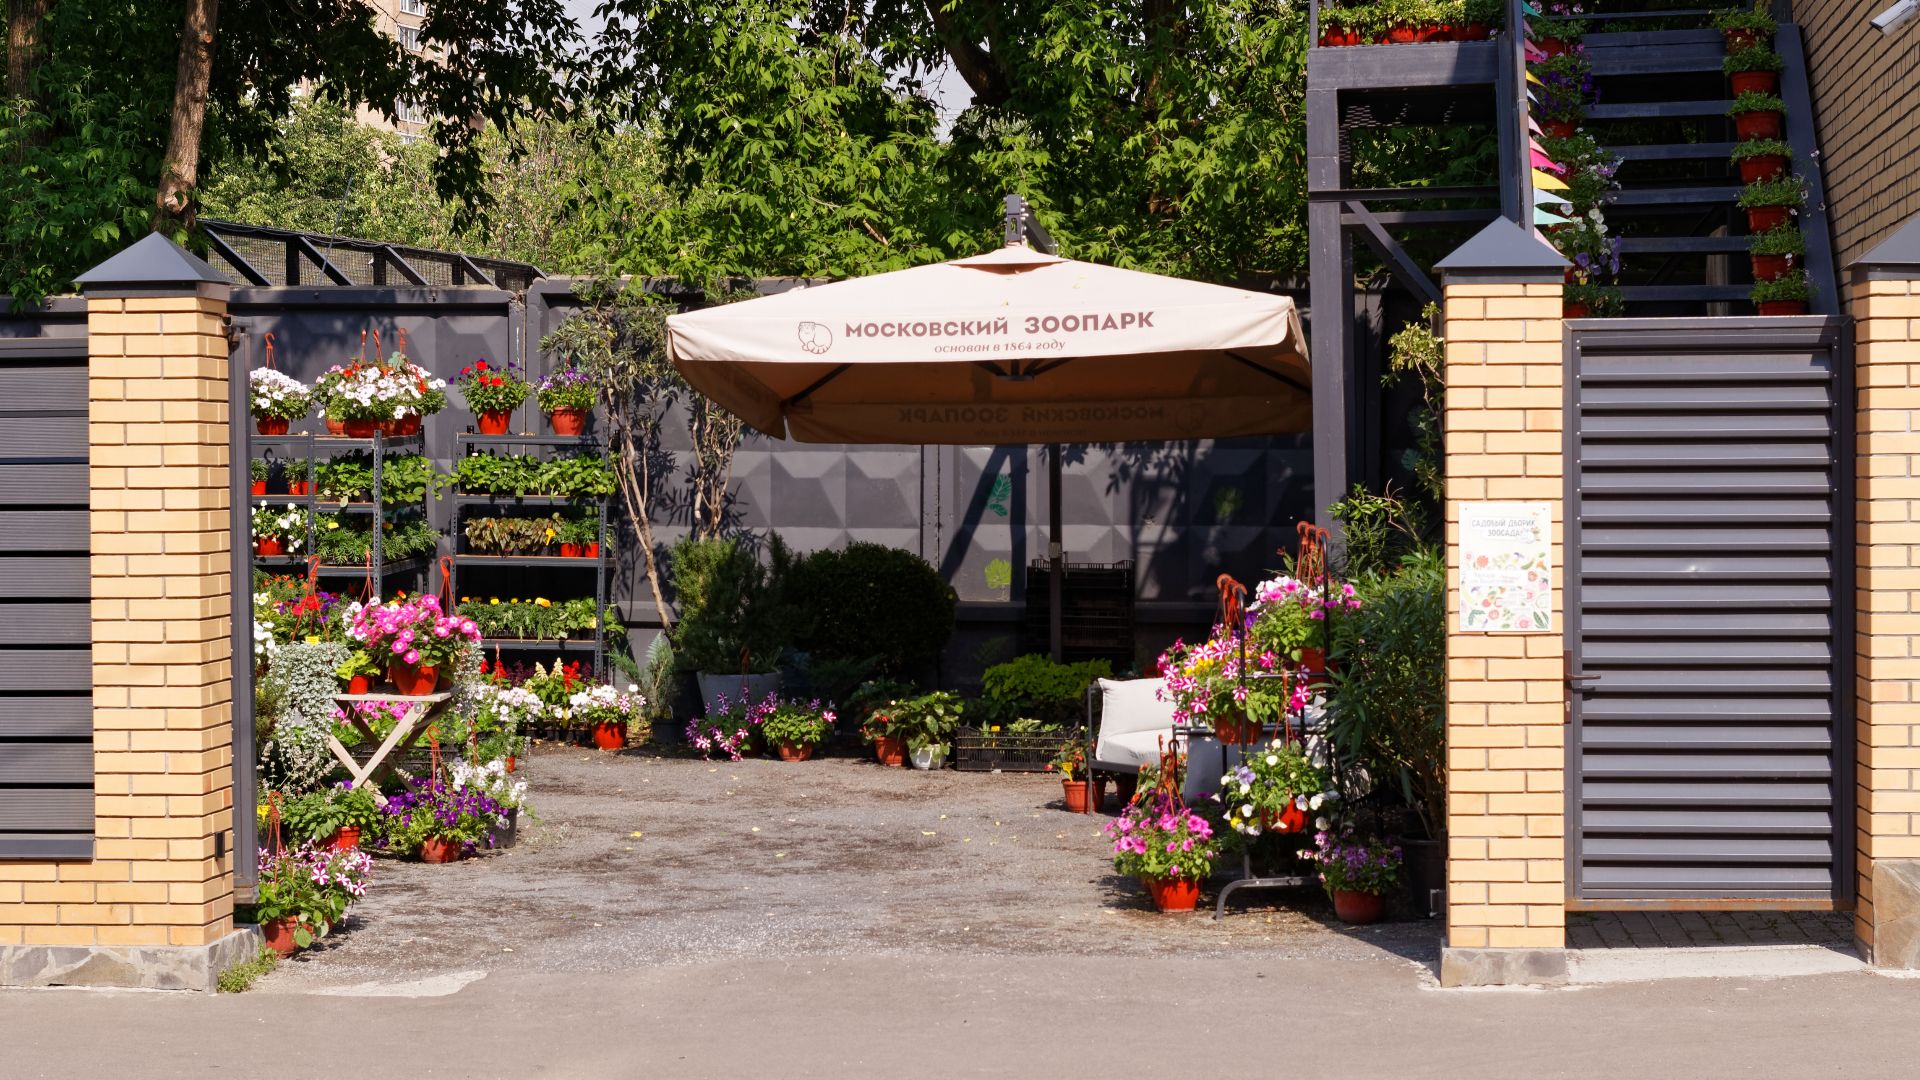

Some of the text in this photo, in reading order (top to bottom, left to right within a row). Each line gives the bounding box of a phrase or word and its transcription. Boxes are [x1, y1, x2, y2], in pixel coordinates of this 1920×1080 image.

[845, 311, 1155, 338] МОСКОВСКИЙ ЗООПАРК
[934, 339, 1066, 353] основан в 1864 году
